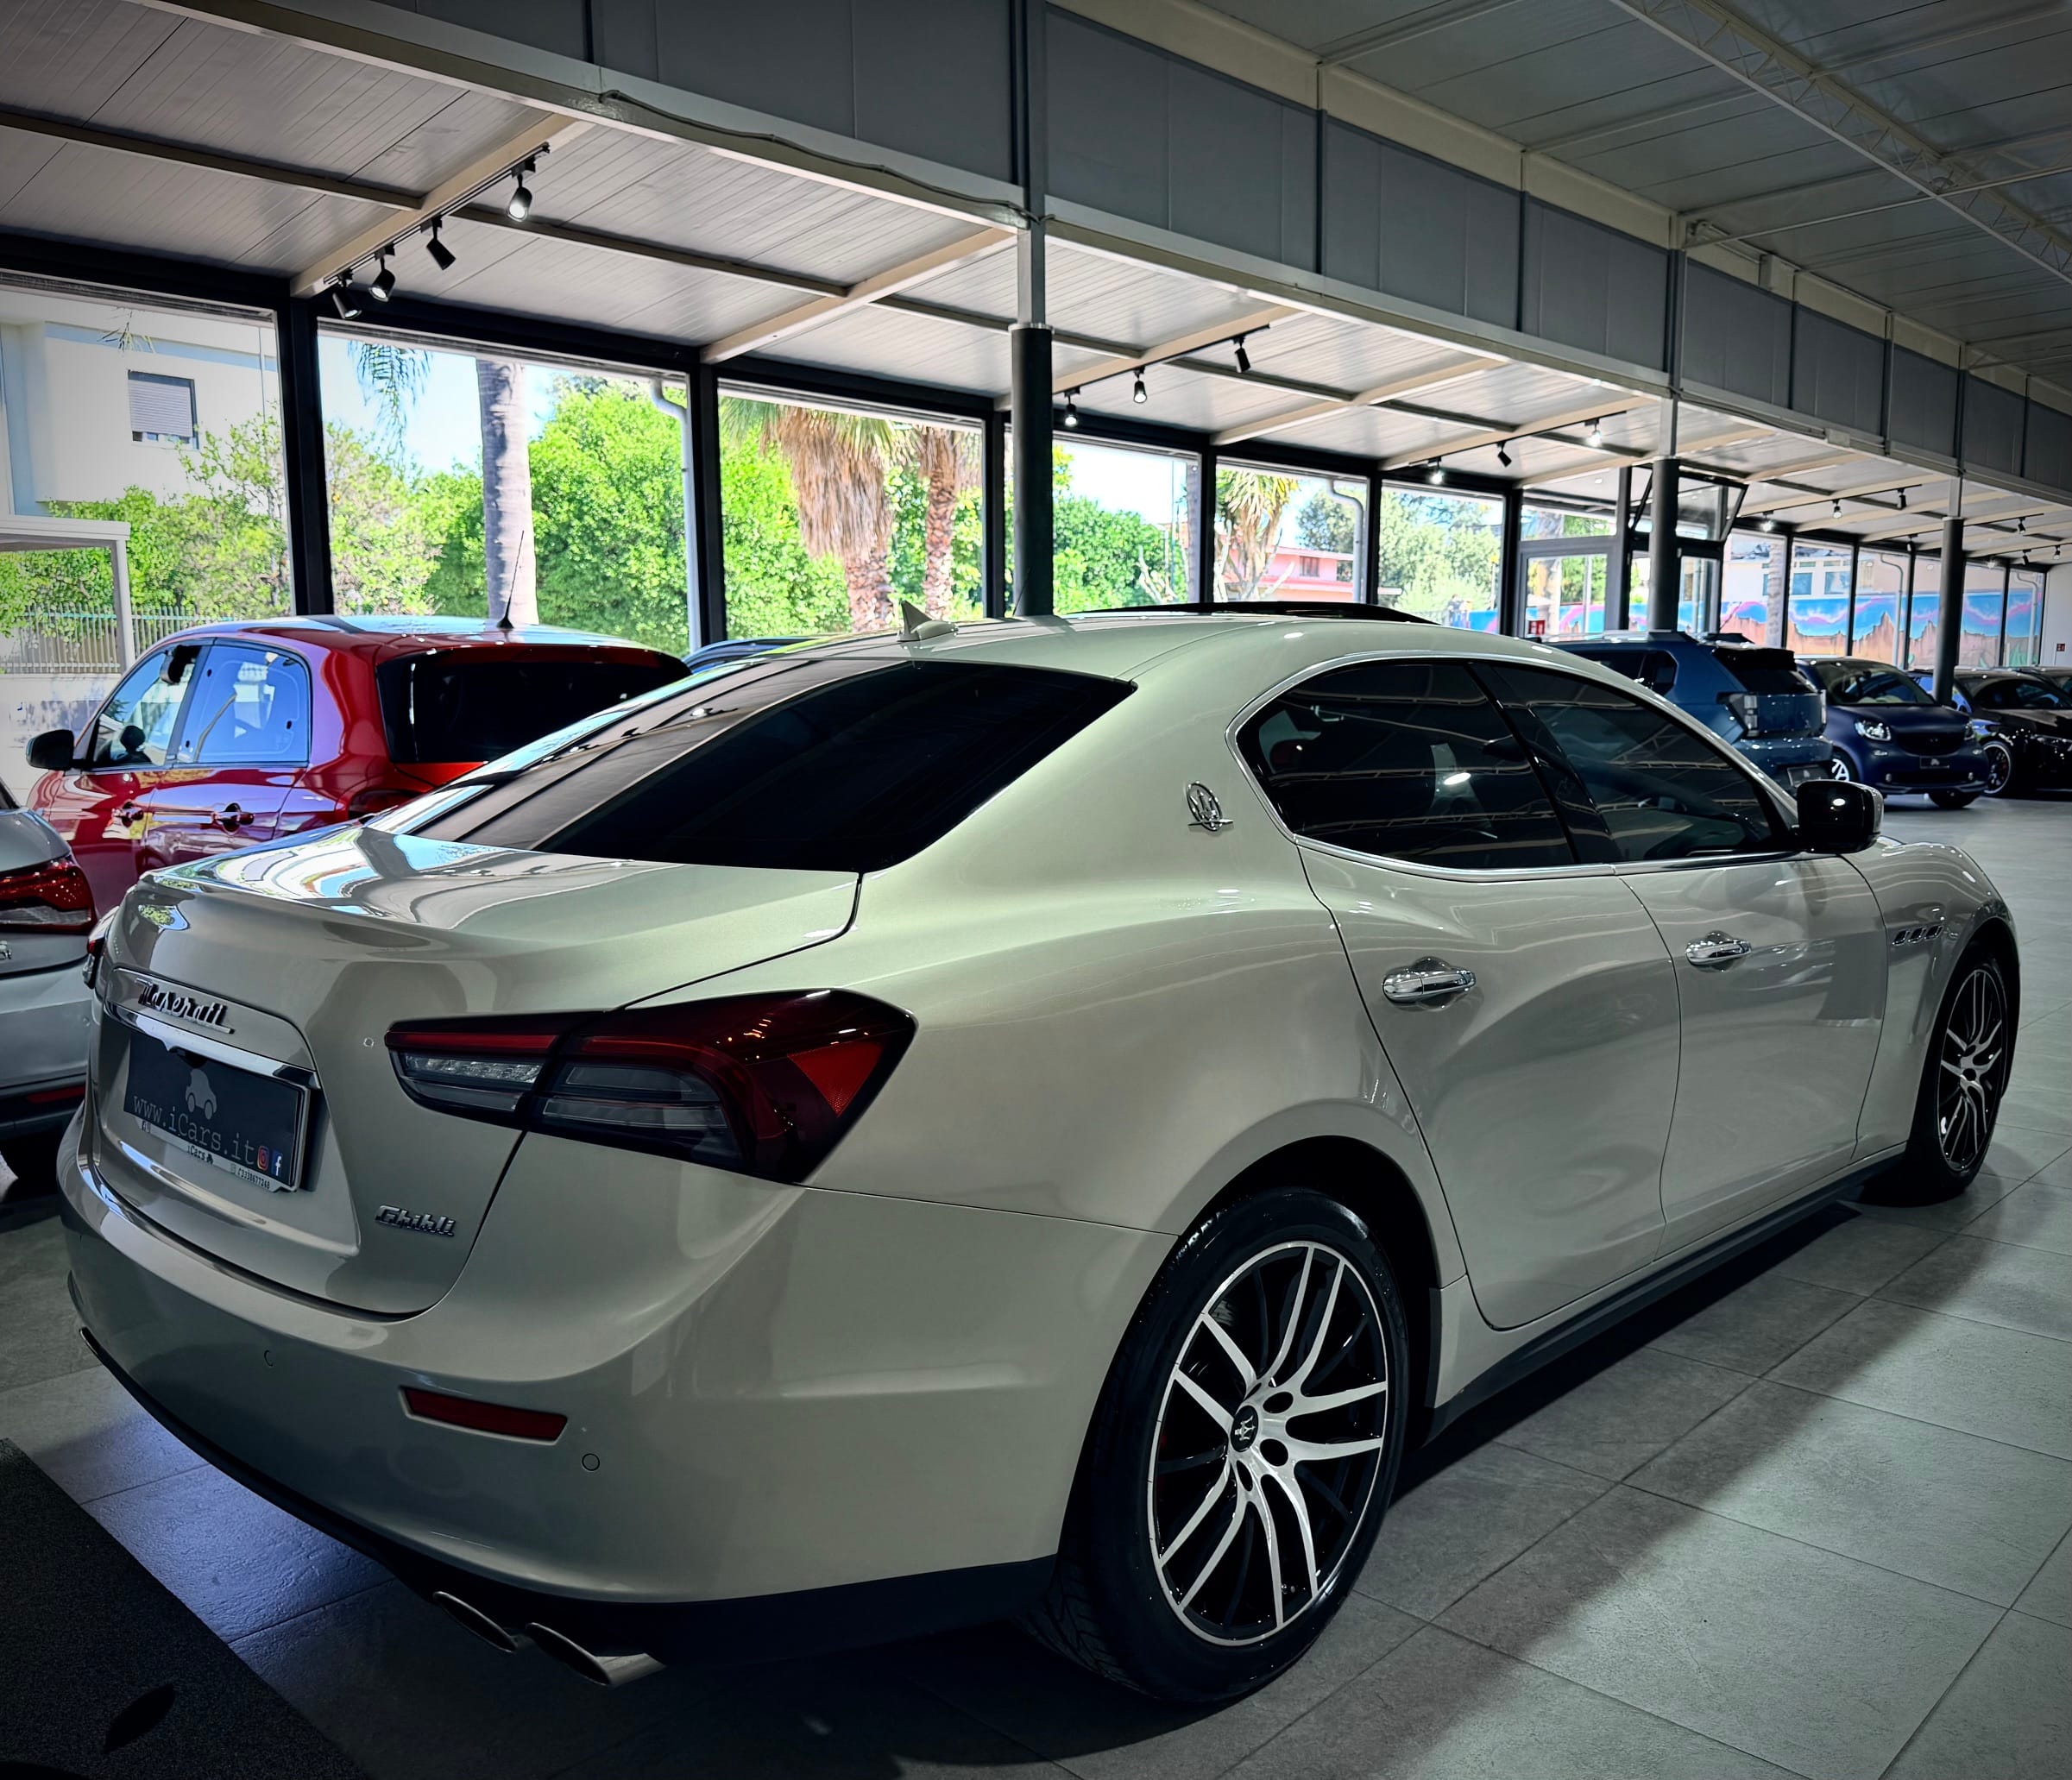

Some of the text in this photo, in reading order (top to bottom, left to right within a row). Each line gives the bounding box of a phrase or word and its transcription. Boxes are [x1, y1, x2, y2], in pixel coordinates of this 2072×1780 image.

[135, 977, 235, 1035] Maserati
[133, 1097, 255, 1165] www.iCars.it
[375, 1204, 456, 1237] Ghibli
